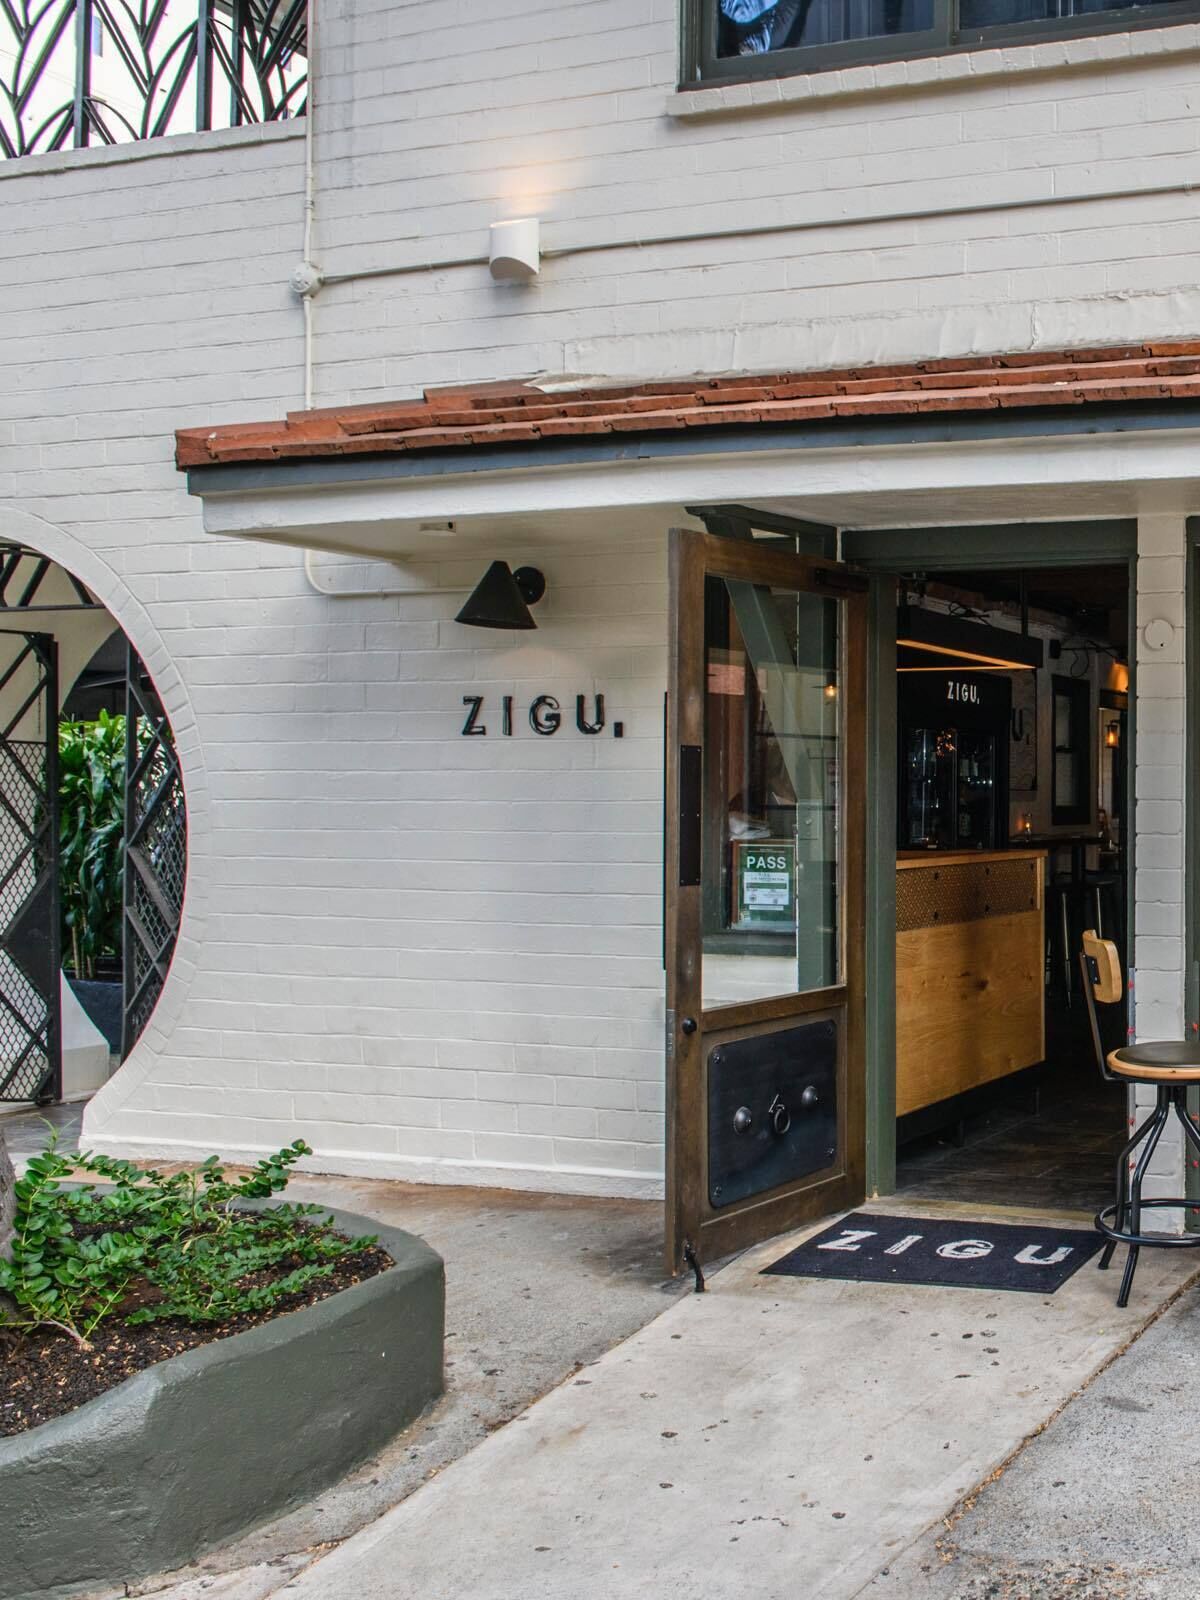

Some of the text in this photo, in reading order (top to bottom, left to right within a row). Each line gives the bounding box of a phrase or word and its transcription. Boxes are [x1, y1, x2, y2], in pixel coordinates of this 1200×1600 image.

[947, 681, 980, 704] ZIGU.
[462, 694, 624, 738] ZIGU.
[747, 856, 786, 869] PASS
[816, 1230, 1074, 1265] ZIGU
